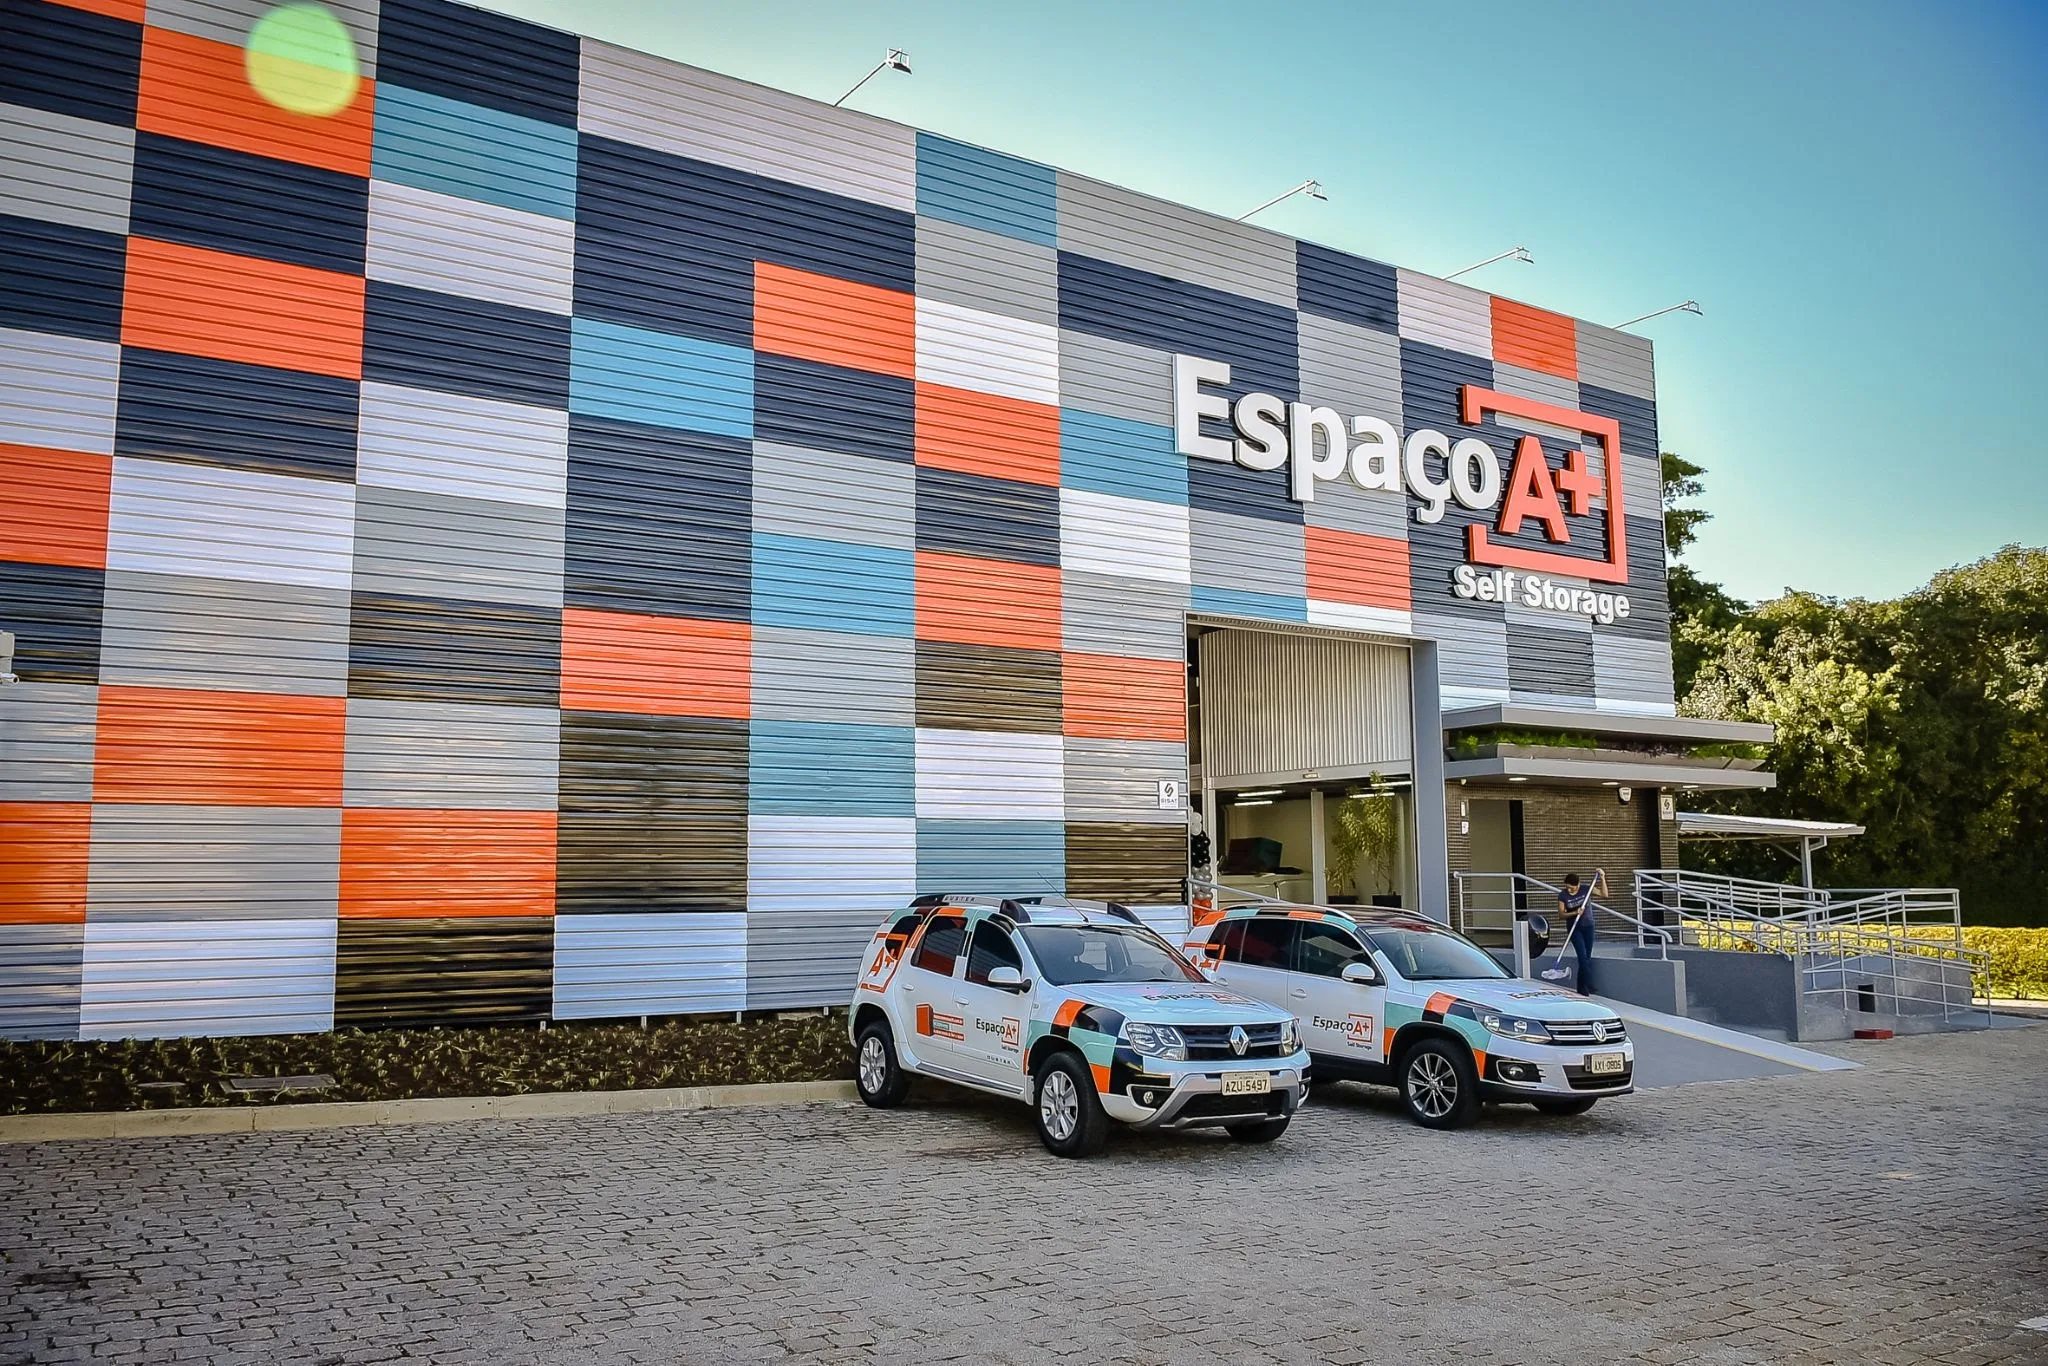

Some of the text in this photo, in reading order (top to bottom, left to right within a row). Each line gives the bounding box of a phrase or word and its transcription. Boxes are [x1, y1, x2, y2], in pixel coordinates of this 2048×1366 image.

[1172, 352, 1603, 543] Espaço A+
[1453, 564, 1631, 624] Self Storage
[975, 1018, 1005, 1036] Espaço
[1004, 1024, 1017, 1039] A+
[1312, 1015, 1369, 1035] Espaço A+
